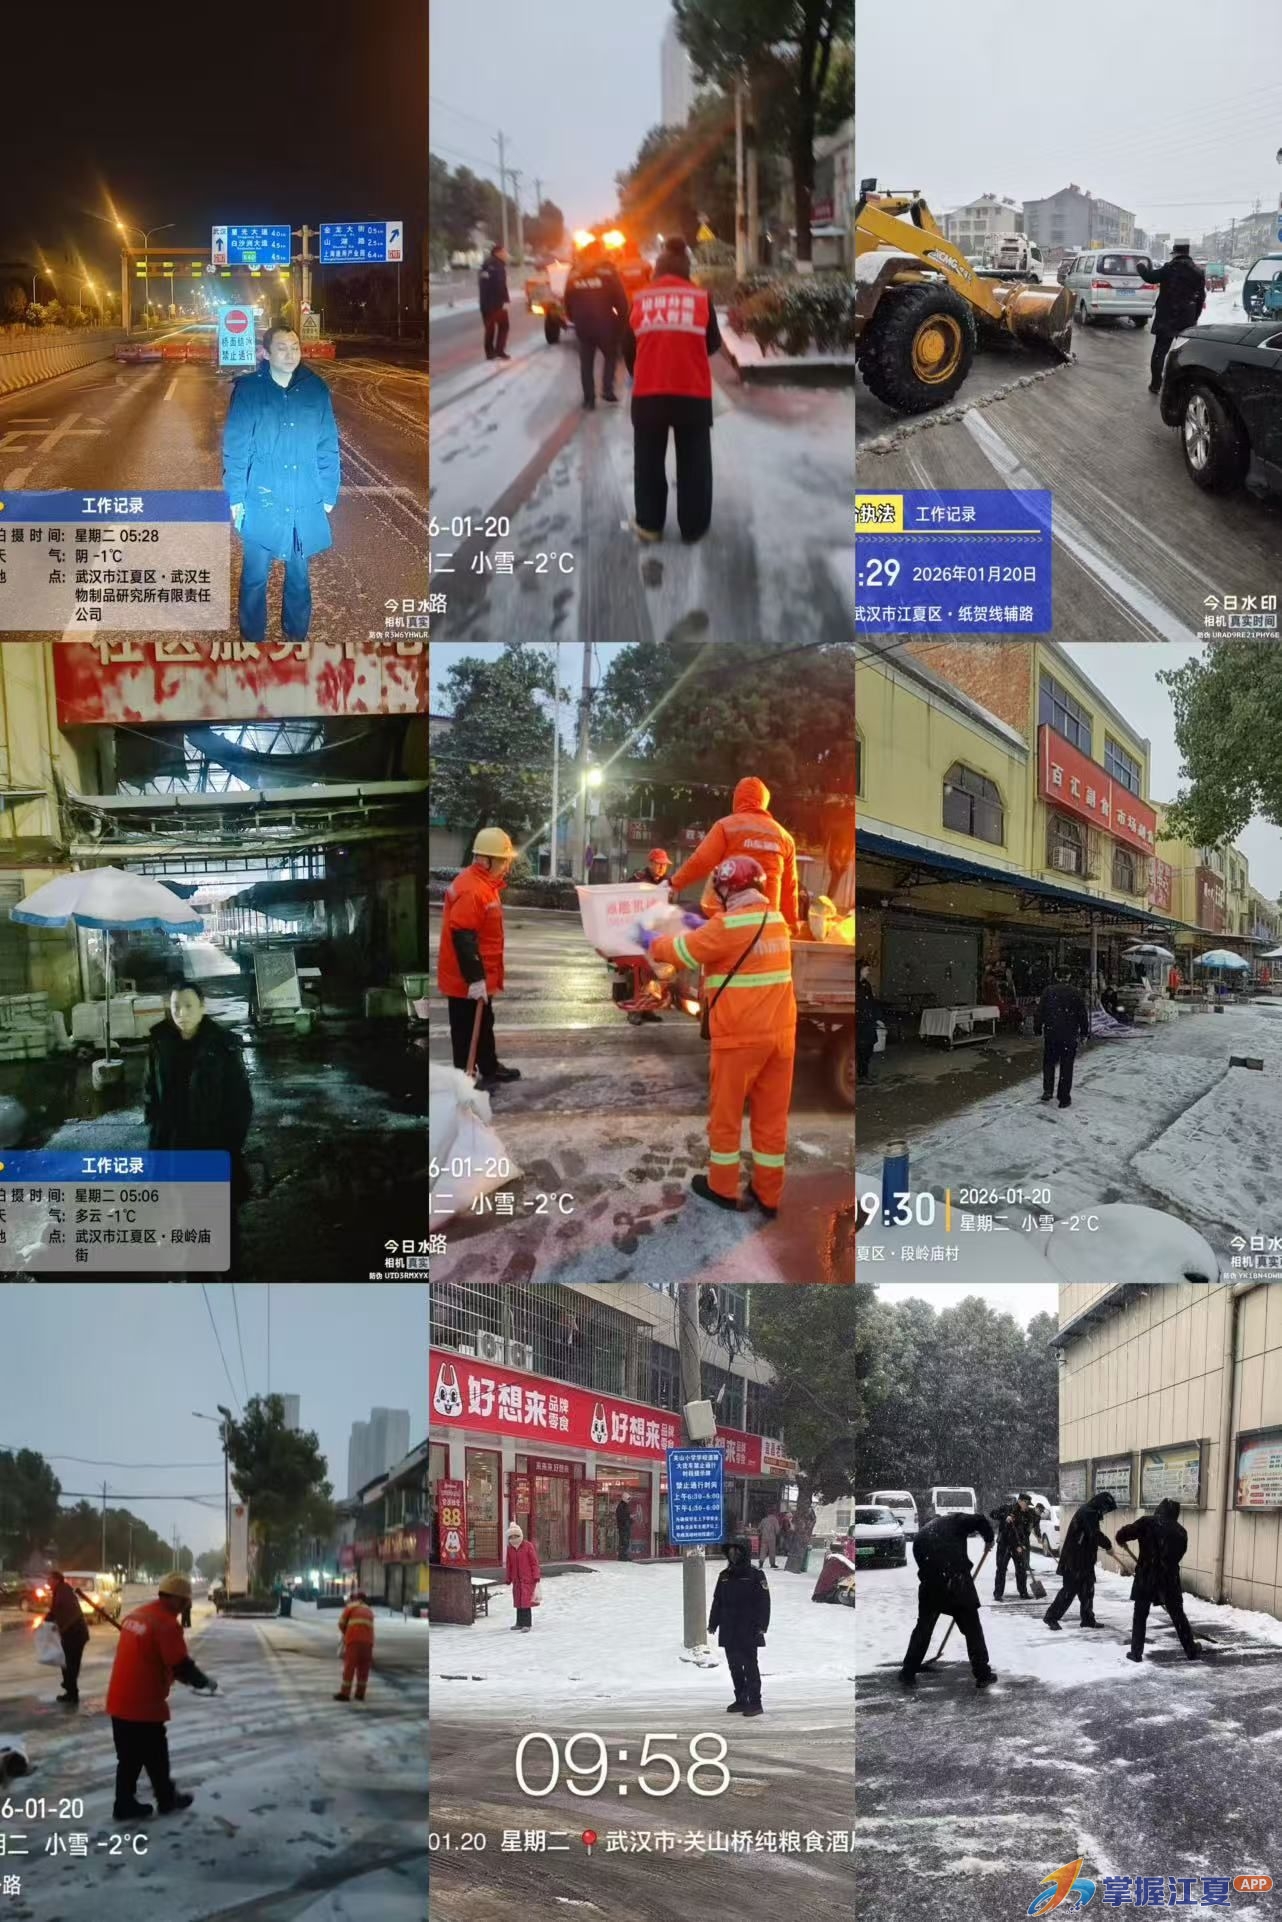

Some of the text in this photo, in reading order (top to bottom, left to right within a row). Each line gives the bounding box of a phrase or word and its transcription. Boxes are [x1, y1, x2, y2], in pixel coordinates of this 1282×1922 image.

[222, 352, 253, 361] 禁止通行
[468, 1375, 547, 1428] 好想来
[550, 1394, 569, 1415] 品牌
[550, 1412, 569, 1432] 零食
[610, 1410, 660, 1450] 好想来
[676, 1482, 718, 1490] 禁止通行时间
